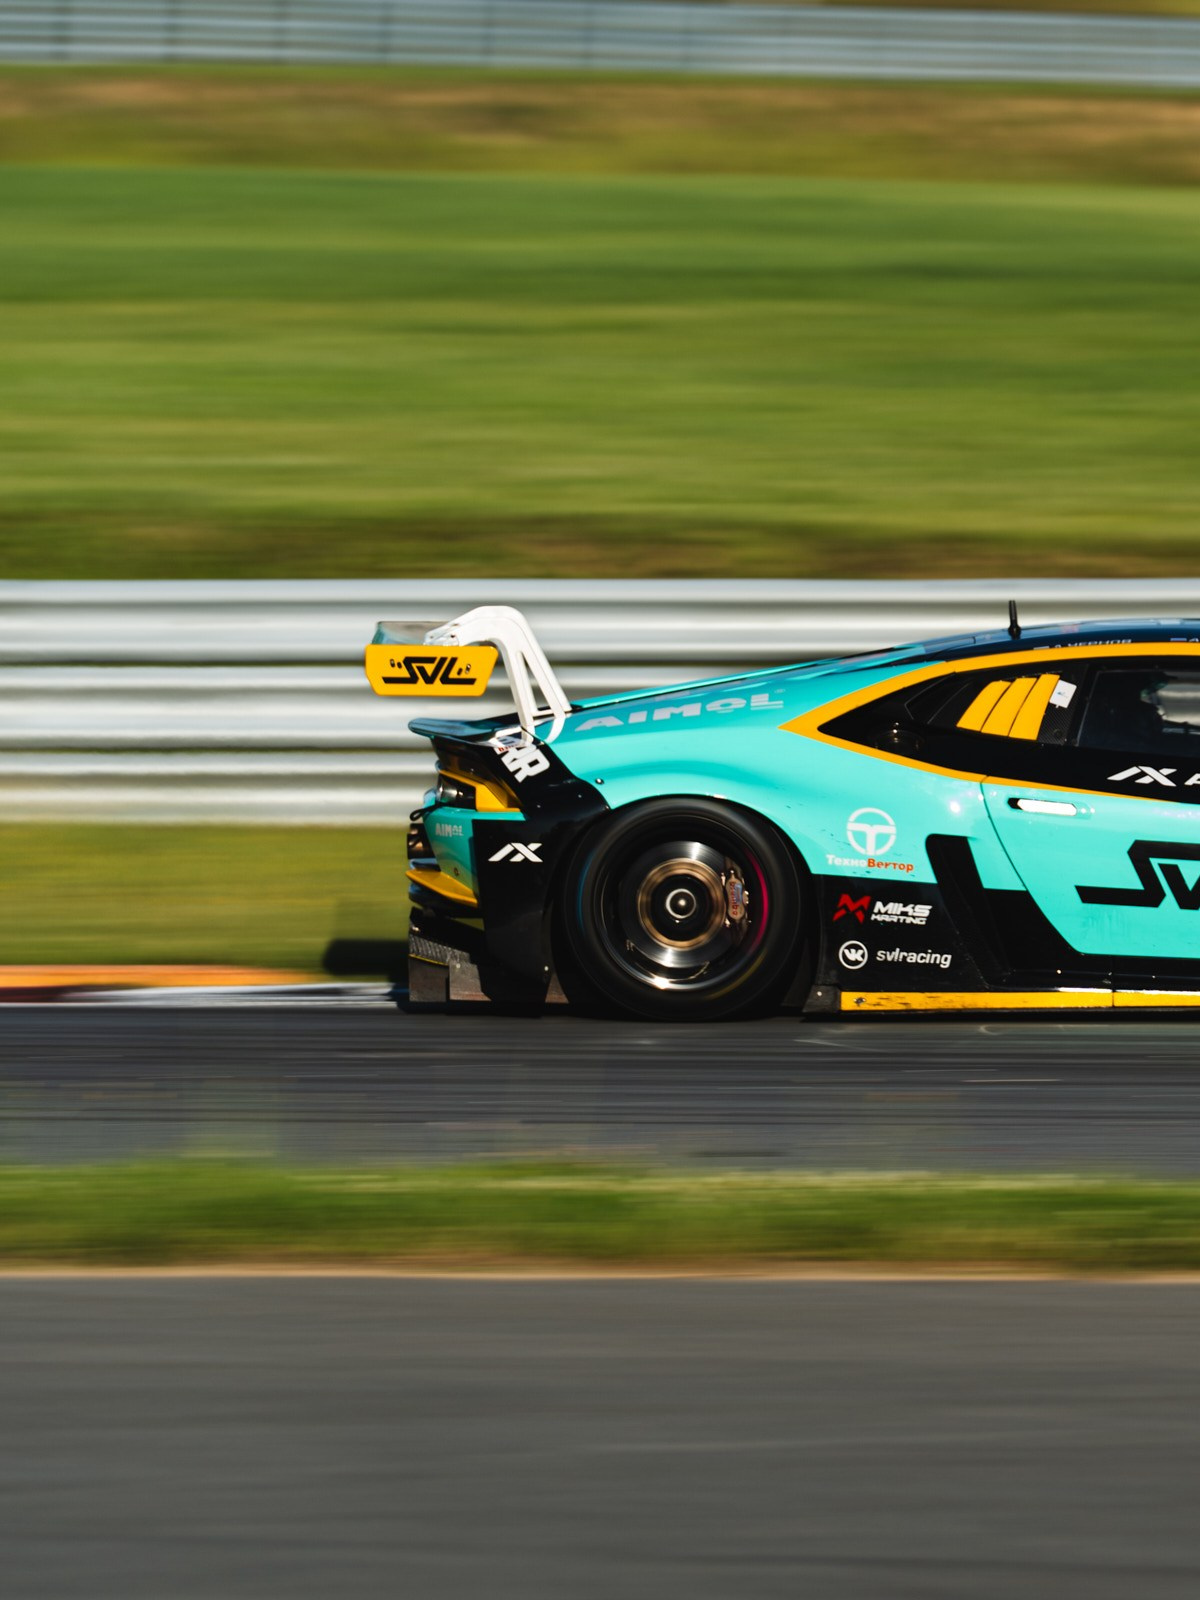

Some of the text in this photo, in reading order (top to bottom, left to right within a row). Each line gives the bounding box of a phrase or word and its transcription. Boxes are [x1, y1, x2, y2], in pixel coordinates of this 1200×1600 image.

[381, 656, 477, 685] SVL
[574, 693, 784, 732] AIMOL
[873, 901, 933, 918] MIKS
[875, 947, 953, 969] svlracing
